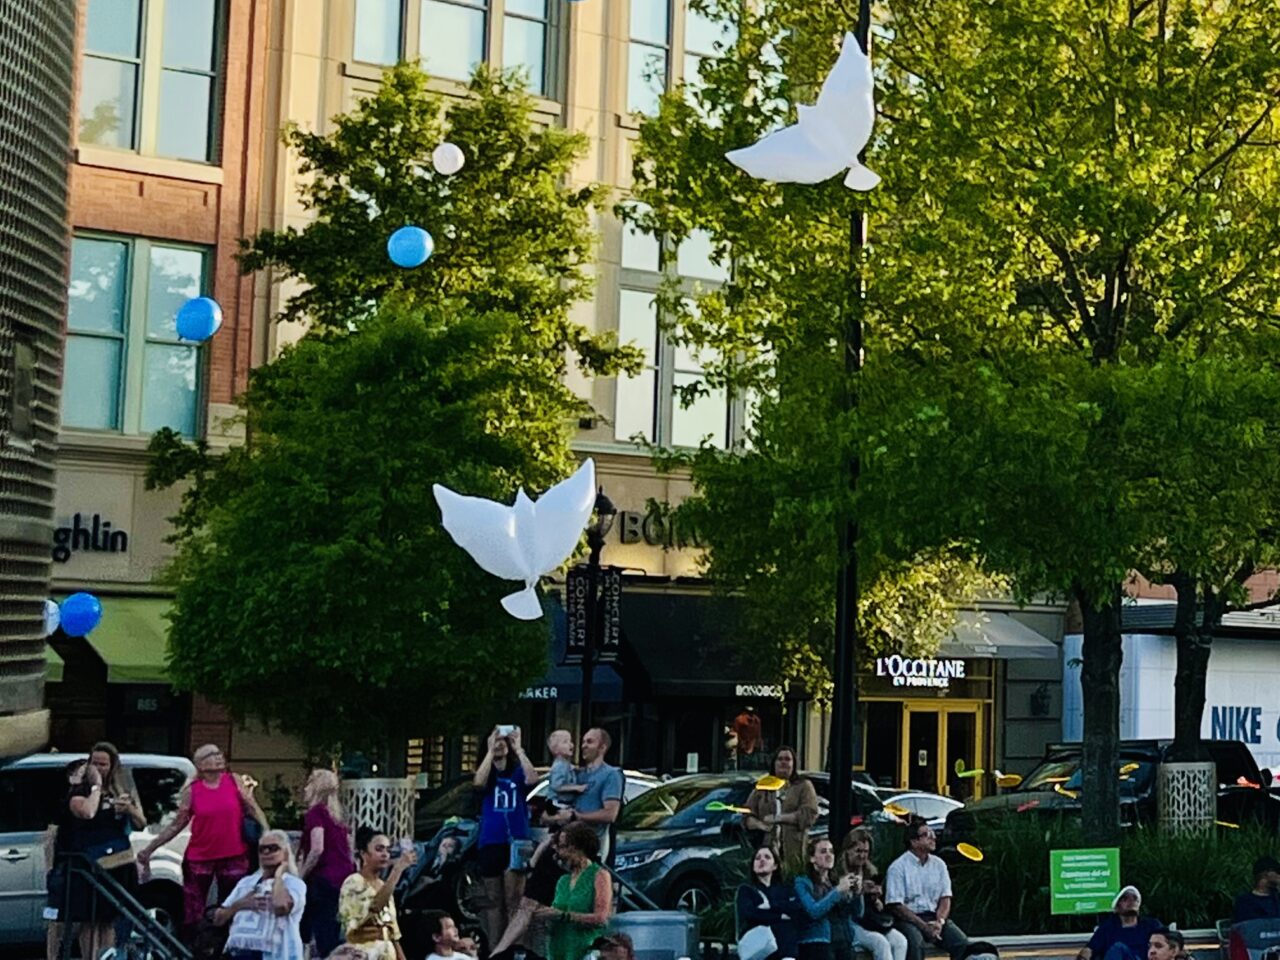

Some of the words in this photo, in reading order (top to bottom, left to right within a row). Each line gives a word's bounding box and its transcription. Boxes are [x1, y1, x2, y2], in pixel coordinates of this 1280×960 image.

[53, 512, 128, 564] ghlin
[576, 577, 586, 647] CONCERT
[876, 654, 966, 678] L'OCCITANE
[1211, 706, 1262, 744] NIKE
[494, 782, 517, 809] hi
